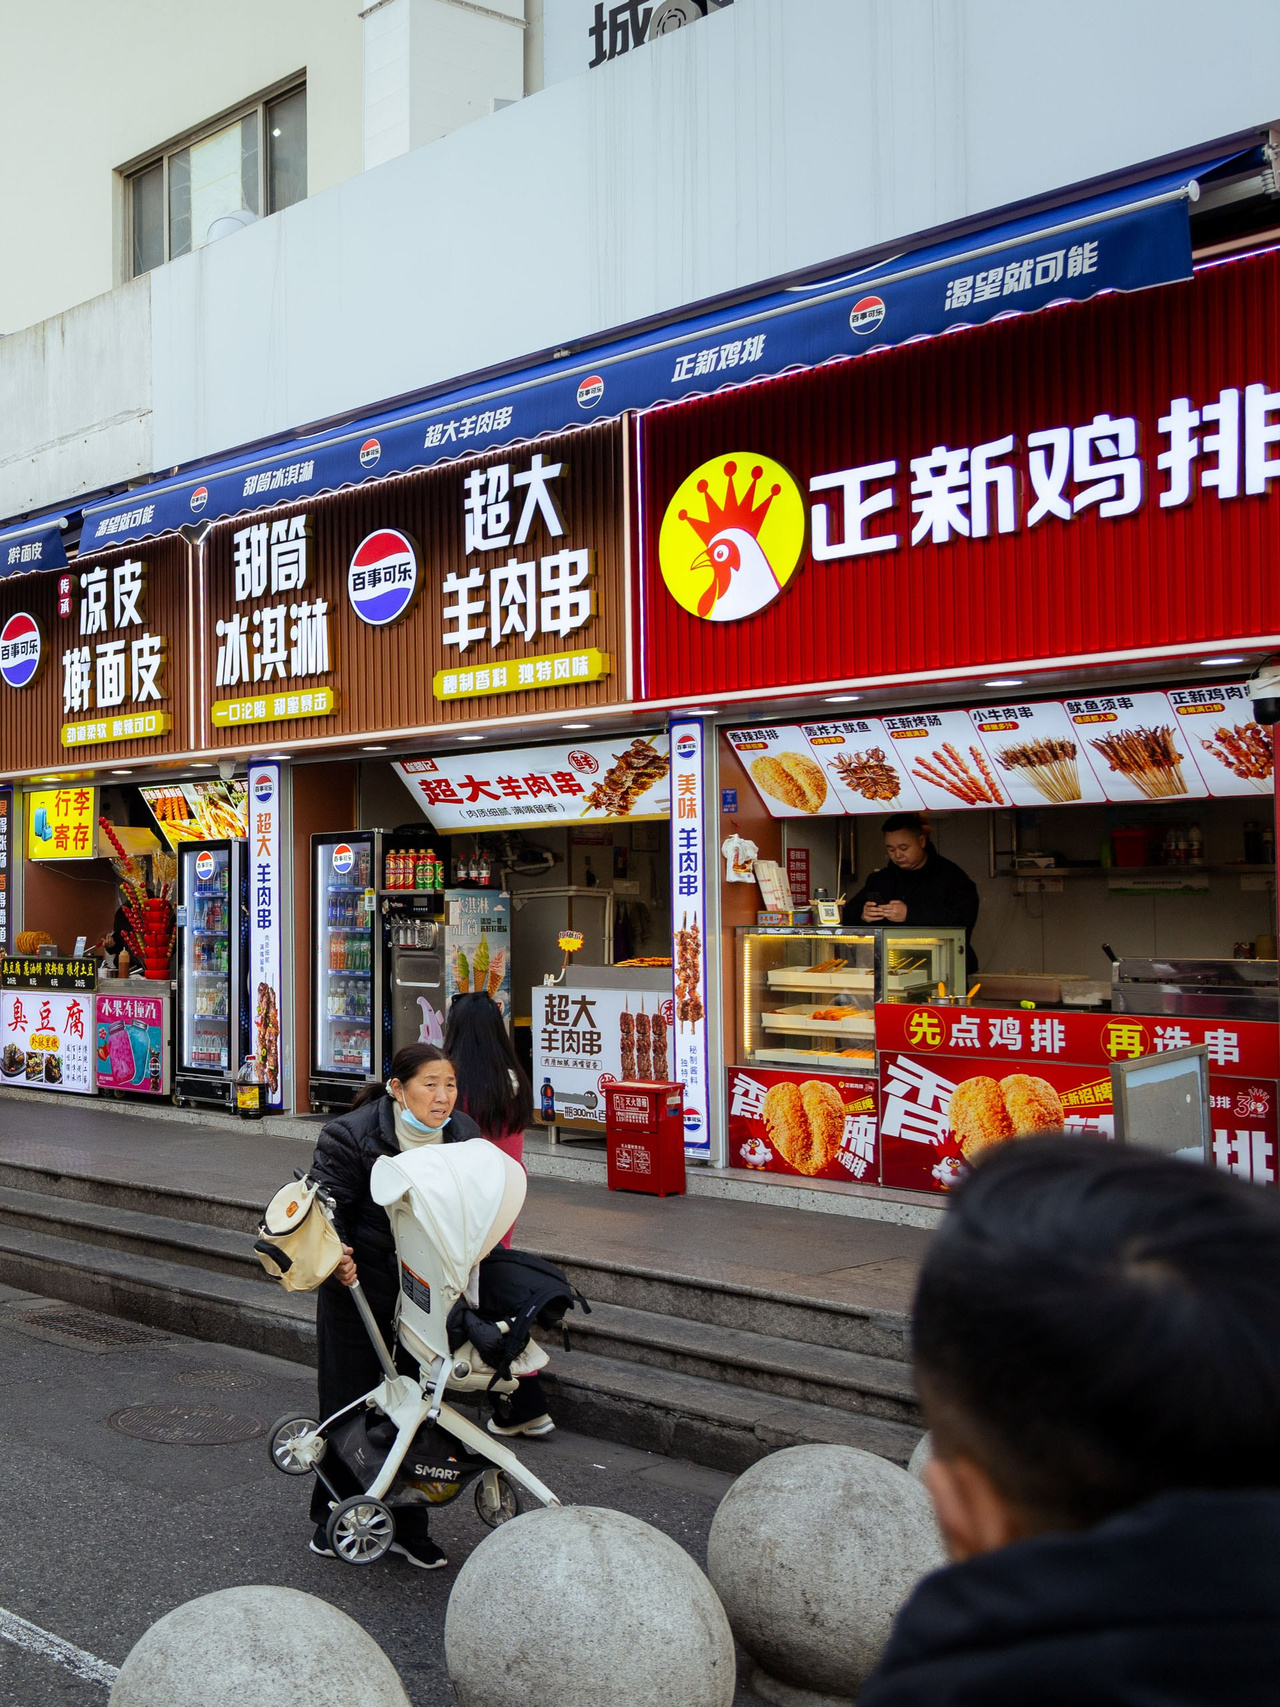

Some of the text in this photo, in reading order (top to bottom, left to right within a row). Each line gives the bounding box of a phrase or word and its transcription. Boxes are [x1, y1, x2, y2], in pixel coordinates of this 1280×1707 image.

[944, 240, 1099, 312] 渴望就可能
[851, 306, 885, 324] 百事可乐
[670, 332, 768, 384] 正新鸡排
[577, 383, 604, 400] 百事可乐
[423, 405, 513, 449] 超大羊肉串
[360, 447, 380, 459] 百事可乐
[243, 459, 315, 498] 甜筒冰淇淋
[809, 382, 1280, 562] 正新鸡排
[95, 504, 156, 538] 渴望就可能
[464, 453, 568, 555] 超大
[8, 542, 43, 565] 擀面皮
[233, 513, 311, 602] 甜筒
[351, 561, 413, 593] 百事可乐
[59, 577, 71, 615] 传承
[80, 558, 144, 636] 凉皮
[442, 548, 595, 655] 羊肉串
[0, 638, 39, 661] 百事可乐
[215, 597, 332, 687] 冰淇淋
[62, 632, 164, 714] 擀面皮
[442, 655, 590, 695] 秘制香料 独特风味
[216, 692, 328, 720] 一口沦陷 甜蜜暴击
[729, 728, 780, 743] 香辣鸡排
[803, 721, 872, 737] 轰炸大鱿鱼
[884, 714, 942, 730] 正新烤肠
[973, 705, 1034, 722] 小牛肉串
[1066, 697, 1134, 714] 鱿鱼须串
[66, 715, 157, 744] 劲道柔软 酸辣可口
[571, 754, 595, 770] 鲜
[54, 788, 90, 818] 行李
[418, 770, 585, 806] 超大羊肉串
[54, 822, 90, 852] 寄存
[677, 772, 698, 897] 美味 羊肉串
[256, 812, 272, 930] 超大 羊肉串
[2, 960, 21, 975] 臭豆腐
[66, 962, 94, 978] 狼牙土豆
[75, 979, 86, 988] 20元
[7, 996, 85, 1041] 臭豆腐
[101, 998, 156, 1019] 水果冻撞奶
[544, 993, 597, 1029] 超大
[30, 1035, 59, 1050] 外酥里嫩
[540, 1027, 602, 1057] 羊肉串
[909, 1012, 1240, 1066] 先点鸡排 再选串
[689, 1045, 698, 1085] 秘制酱料
[730, 1072, 770, 1119] 香
[834, 1148, 869, 1180] 大鸡排
[414, 1463, 461, 1481] SMART
